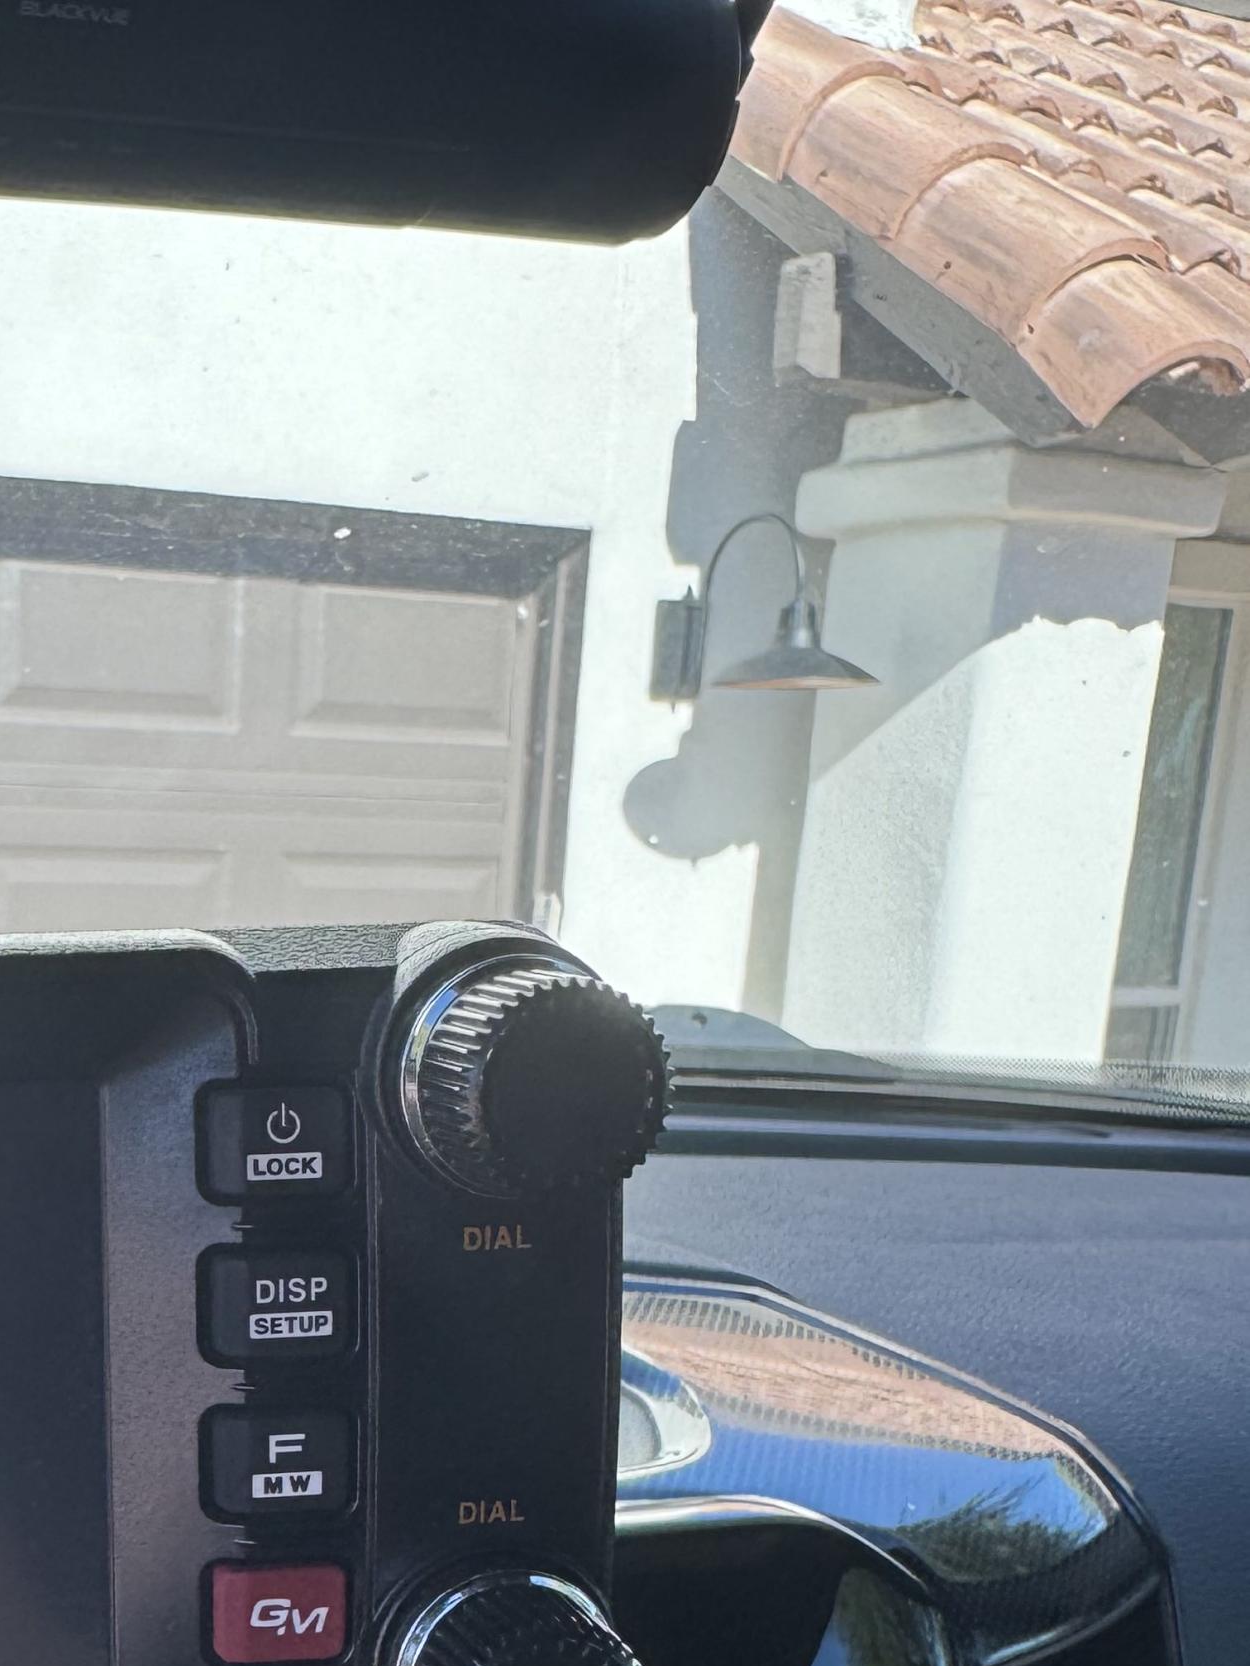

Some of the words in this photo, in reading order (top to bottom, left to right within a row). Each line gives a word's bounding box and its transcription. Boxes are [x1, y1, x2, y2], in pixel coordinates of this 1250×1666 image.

[251, 1156, 318, 1177] LOCK
[462, 1224, 532, 1252] DIAL
[255, 1276, 328, 1304] DISP
[253, 1315, 329, 1336] SETUP
[268, 1433, 306, 1464] F
[457, 1498, 526, 1525] DIAL
